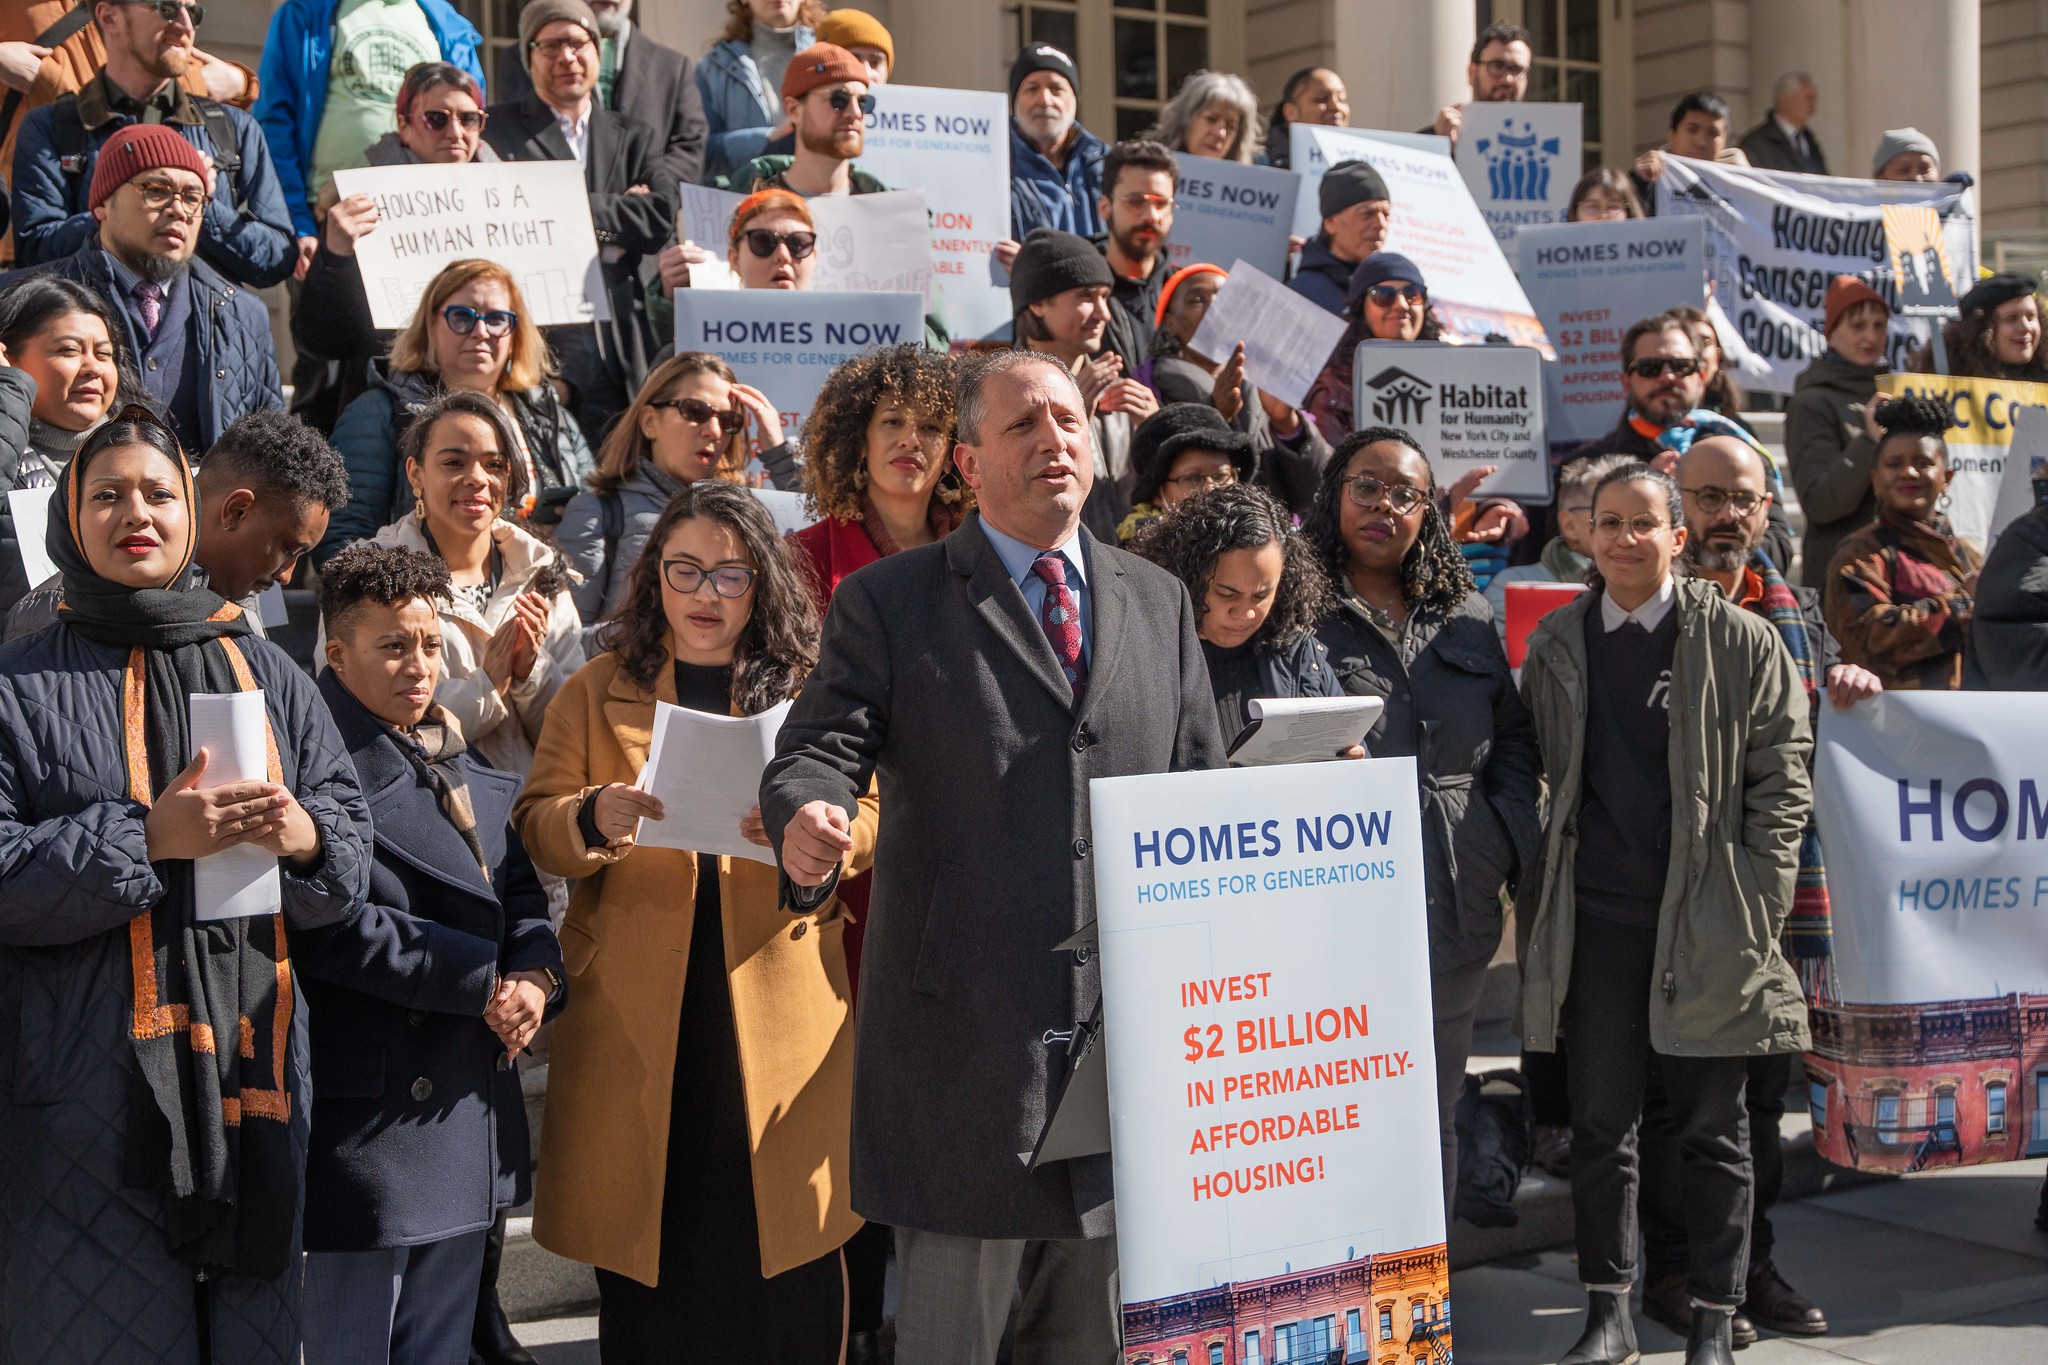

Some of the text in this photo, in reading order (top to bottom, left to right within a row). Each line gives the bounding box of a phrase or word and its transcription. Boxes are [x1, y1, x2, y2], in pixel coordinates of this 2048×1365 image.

[865, 111, 990, 136] OMES NOW
[374, 184, 529, 222] HOUSING IS A
[1220, 184, 1280, 210] NOW
[1486, 210, 1553, 224] NANTS
[390, 220, 555, 259] HUMAN RIGHT
[1772, 203, 1887, 263] Housing
[1537, 238, 1687, 265] HOMES NOW
[1559, 309, 1611, 324] INVEST
[703, 320, 901, 346] HOMES NOW
[1560, 329, 1583, 347] $2
[763, 352, 793, 365] FOR
[1561, 353, 1576, 366] IN
[1440, 384, 1528, 408] Habitat
[1440, 411, 1459, 425] for
[1441, 430, 1531, 443] New York City and
[1441, 448, 1537, 461] Westchester County
[1134, 810, 1392, 869] HOMES NOW
[1137, 860, 1396, 904] HOMES FOR GENERATIONS
[1899, 876, 2022, 911] HOMES
[1181, 972, 1272, 1008] INVEST
[1183, 1004, 1369, 1064] $2 BILLION
[1187, 1051, 1414, 1108] IN PERMANENTLY-
[1190, 1103, 1360, 1155] AFFORDABLE
[1193, 1155, 1325, 1202] HOUSING!
